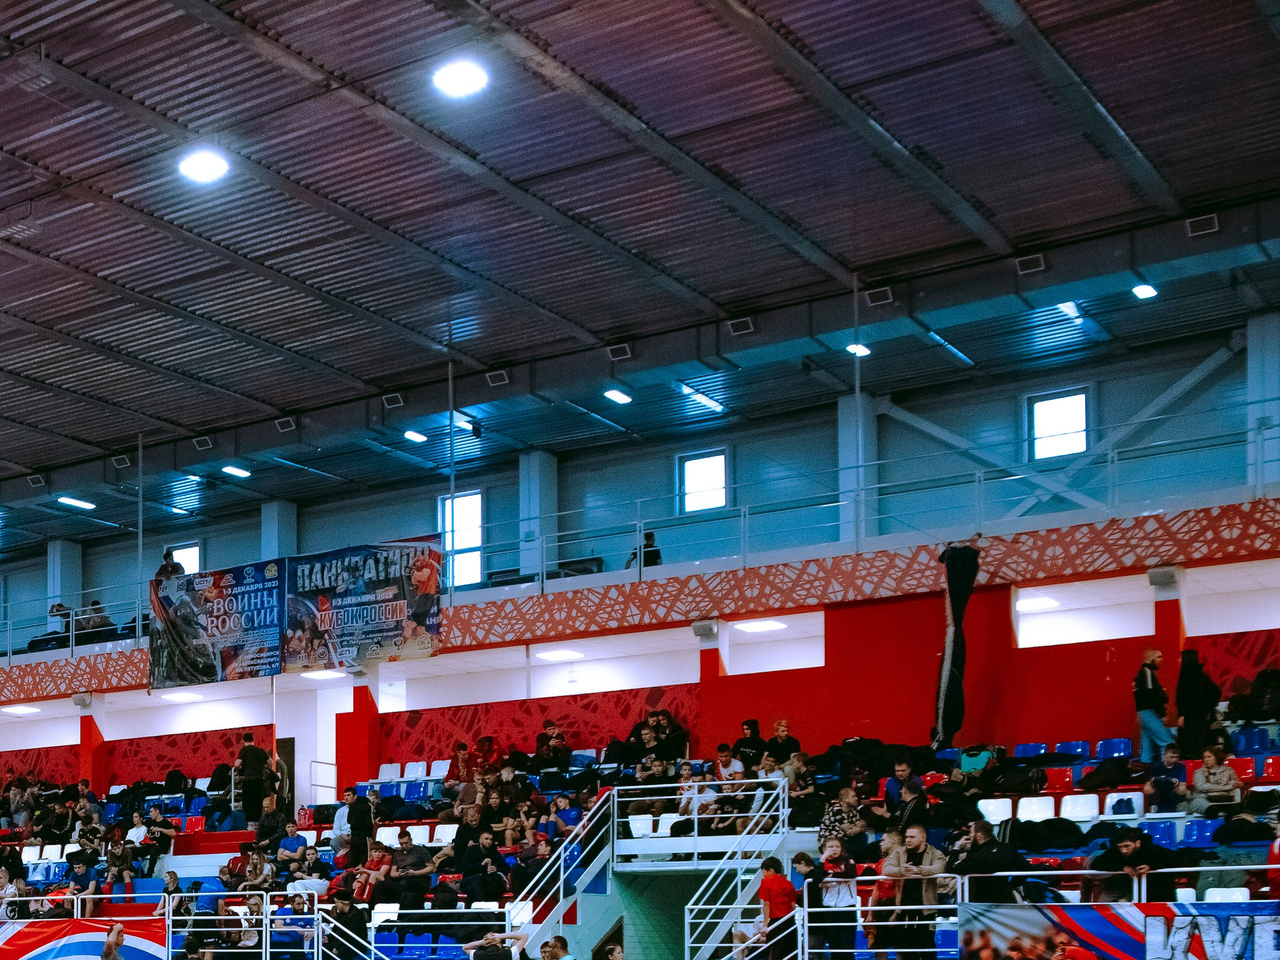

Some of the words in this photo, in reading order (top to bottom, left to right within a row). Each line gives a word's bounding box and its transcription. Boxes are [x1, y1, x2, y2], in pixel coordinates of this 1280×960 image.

[213, 588, 279, 616] ВОИНЫ
[232, 582, 263, 594] ДЕКАБРЯ
[207, 607, 279, 635] РОССИИ
[318, 607, 361, 631] КУБОК
[360, 600, 407, 624] РОССИИ
